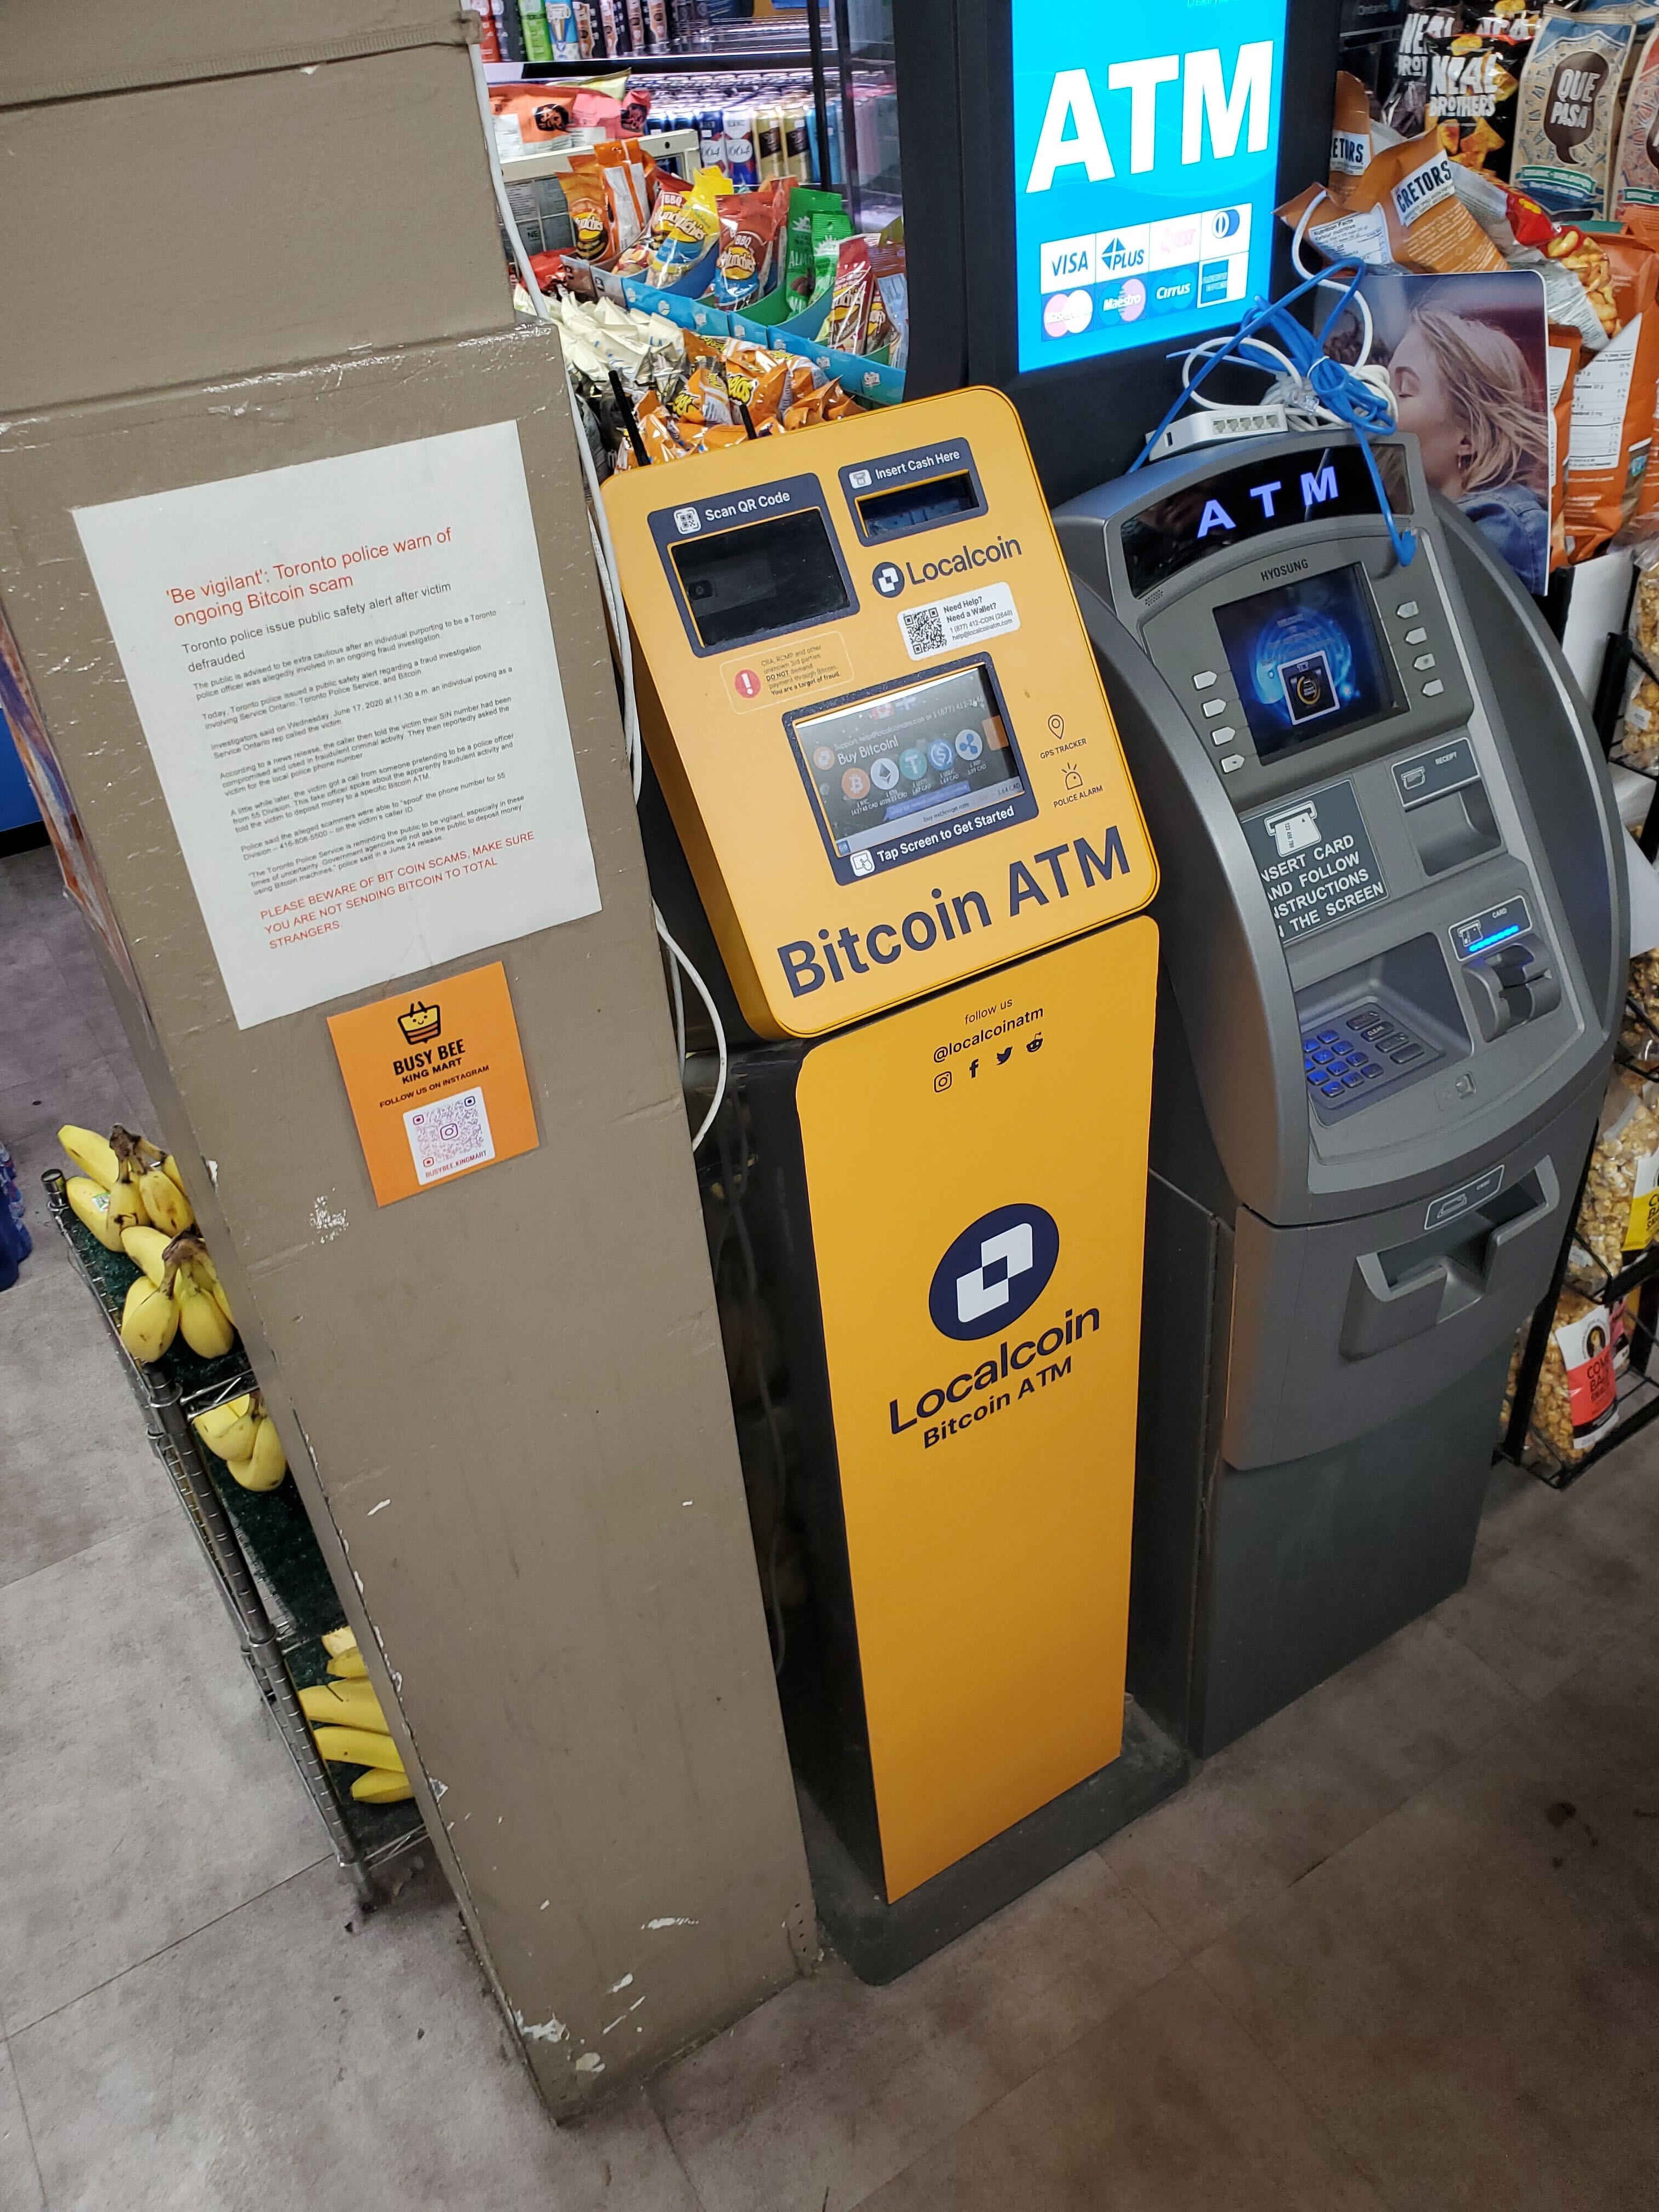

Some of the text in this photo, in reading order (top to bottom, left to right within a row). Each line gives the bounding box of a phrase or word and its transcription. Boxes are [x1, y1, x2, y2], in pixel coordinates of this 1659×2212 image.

[1430, 54, 1498, 94] NEAL
[1558, 69, 1600, 103] QUE
[1025, 40, 1274, 193] ATM
[1429, 94, 1496, 117] BROTHERS
[1550, 101, 1591, 128] PASA
[664, 194, 682, 206] BBQ
[1397, 160, 1452, 213] CRETORS
[734, 235, 752, 249] BBQ
[1052, 251, 1088, 276] VISA
[1114, 249, 1144, 270] PLUS
[1103, 295, 1142, 311] Maestro
[1156, 282, 1191, 301] Cirrus
[874, 451, 960, 479] Insert Cash Here
[704, 491, 790, 521] Scan QR Code
[1197, 466, 1339, 538] ATM
[166, 526, 452, 604] 'Be vigilant': Toronto police warn of
[905, 535, 1022, 585] Localcoin
[1260, 559, 1309, 582] HYOSUNG
[173, 575, 353, 627] ongoing Bitcoin scam
[943, 595, 982, 613] Need Help?
[946, 611, 965, 623] Need
[970, 602, 996, 616] Wallet?
[180, 583, 452, 654] Toronto police issue public safety alert after victim
[953, 622, 968, 633] (877)
[968, 614, 995, 628] 412-COIN
[188, 648, 246, 673] defrauded
[192, 681, 209, 691] The
[210, 675, 234, 688] public
[242, 664, 272, 678] advised
[292, 655, 312, 665] extra
[313, 647, 344, 660] cautious
[345, 642, 362, 652] after
[374, 630, 408, 645] individual
[408, 622, 444, 639] purporting
[469, 610, 497, 622] Toronto
[765, 673, 776, 682] DO
[775, 669, 790, 679] NOT
[771, 687, 783, 696] You
[782, 685, 793, 693] are
[797, 678, 816, 690] target
[837, 735, 900, 768] Buy Bitcoin!
[1040, 738, 1087, 759] GPS TRACKER
[1053, 785, 1103, 808] POLICE ALARM
[876, 805, 1014, 861] Tap Screen to Get Started
[1261, 834, 1354, 882] NSERT CARD
[259, 831, 534, 920] PLEASE BEWARE OF BIT COIN SCAMS, MAKE SURE
[1267, 851, 1359, 901] ND FOLLOW
[263, 856, 498, 934] YOU ARE NOT SENDING BITCOIN TO TOTAL
[1273, 868, 1369, 919] NSTRUCTIONS
[1289, 909, 1321, 932] THE
[1325, 881, 1384, 916] SCREEN
[776, 825, 1130, 998] Bitcoin ATM
[1492, 908, 1507, 919] CARD
[964, 997, 1014, 1025] follow us
[933, 1006, 1044, 1063] @localcoinatm
[392, 1039, 465, 1075] BUSY BEE
[402, 1057, 462, 1084] KING MART
[379, 1064, 489, 1108] FOLLOW US ON INSTAGRAM
[889, 1307, 1101, 1435] Localcoin
[924, 1356, 1072, 1449] Bitcoin ATM
